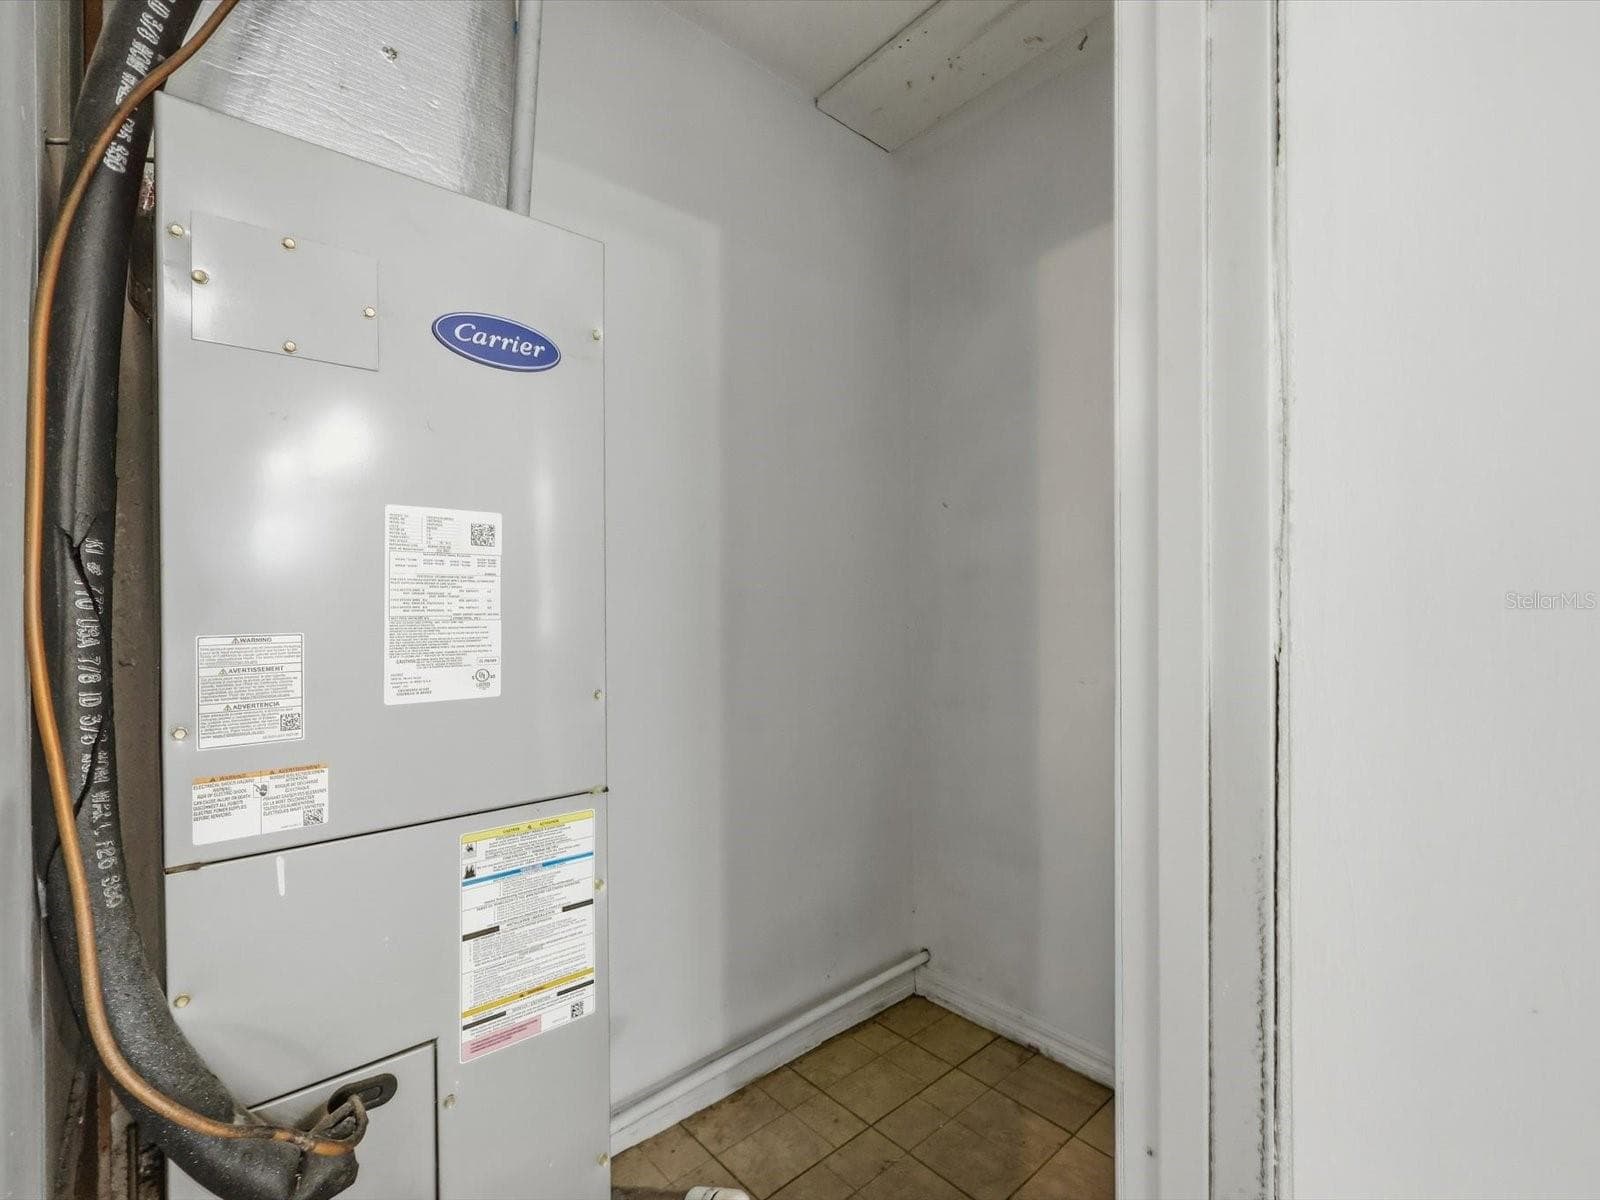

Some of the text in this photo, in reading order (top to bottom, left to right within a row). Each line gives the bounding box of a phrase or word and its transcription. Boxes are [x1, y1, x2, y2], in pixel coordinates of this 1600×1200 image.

[454, 323, 545, 358] Carrier
[76, 618, 100, 648] USA
[78, 655, 102, 684] 7/8
[228, 666, 284, 674] AVERTISSEMENT
[78, 692, 102, 708] ID
[233, 701, 280, 710] ADVERTENCIA
